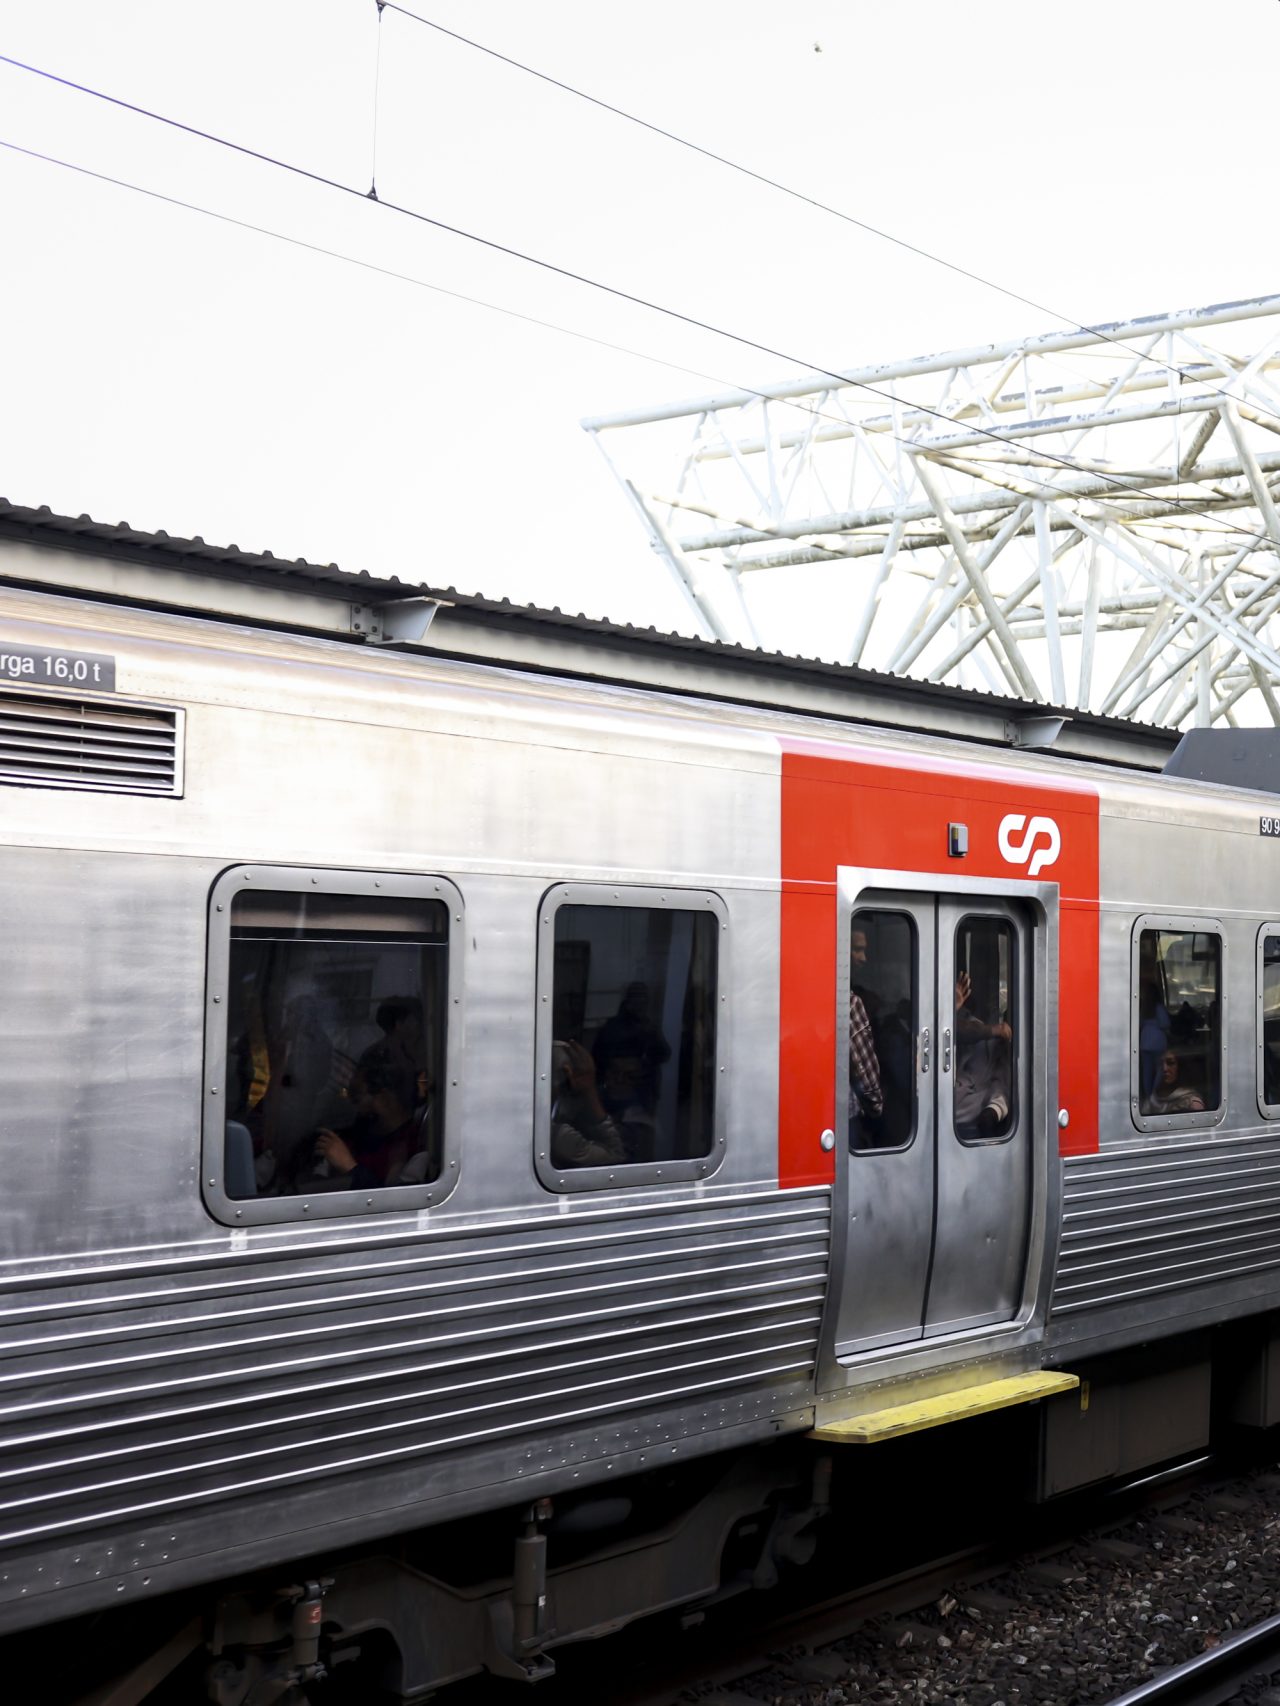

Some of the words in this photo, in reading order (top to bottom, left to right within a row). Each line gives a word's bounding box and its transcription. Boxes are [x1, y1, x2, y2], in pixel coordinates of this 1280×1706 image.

[43, 656, 88, 682] 16,0
[93, 662, 101, 682] t
[1261, 817, 1273, 834] 90
